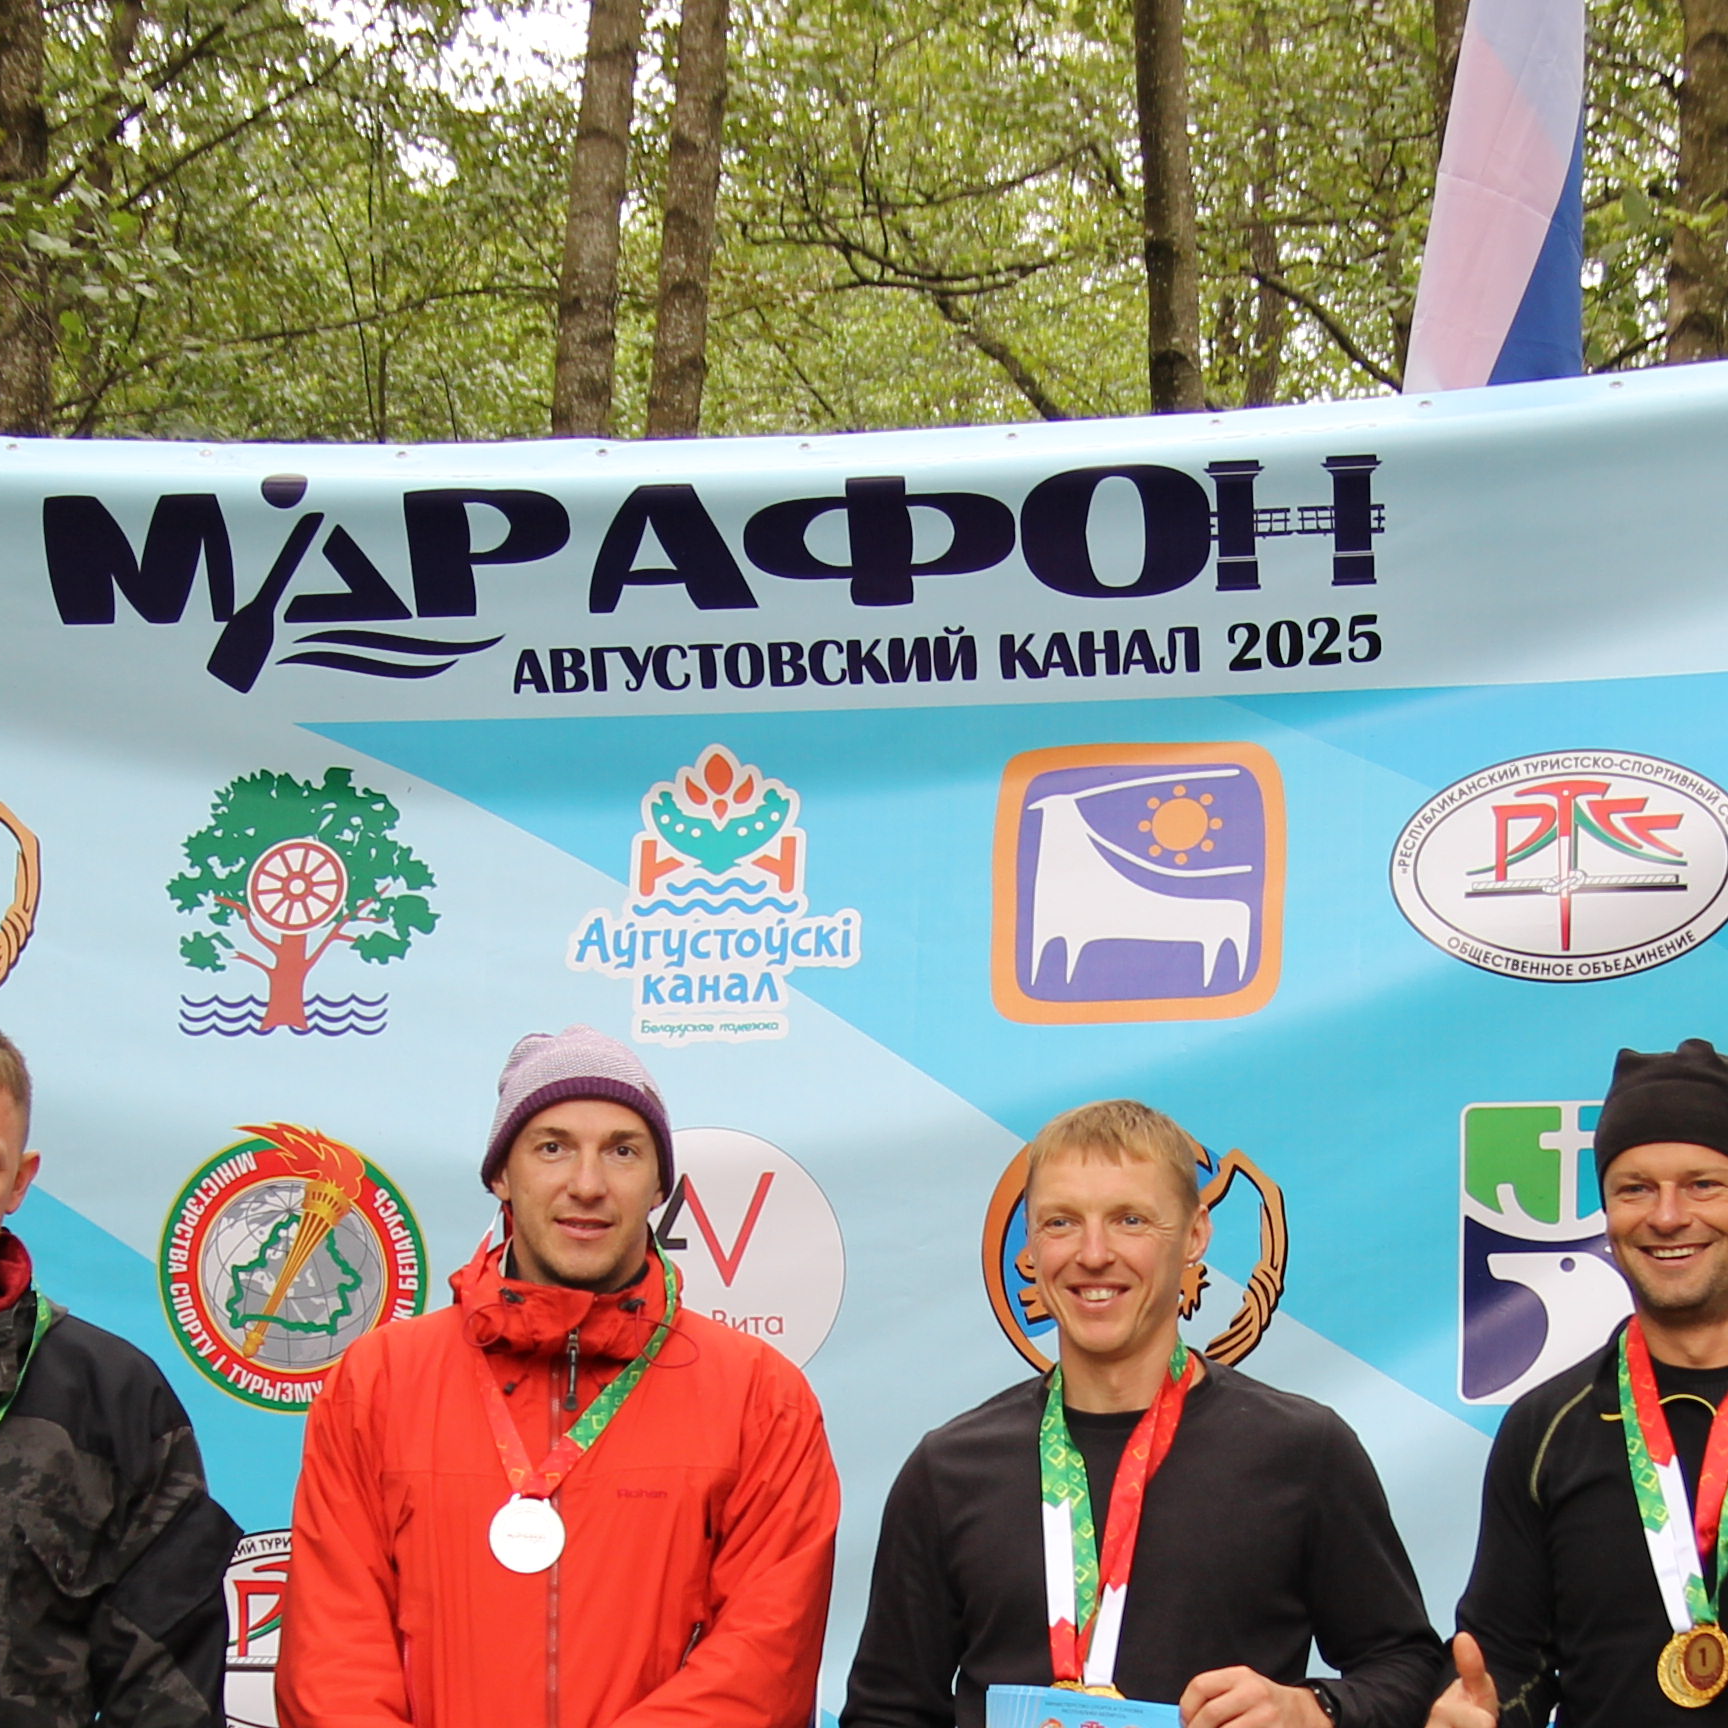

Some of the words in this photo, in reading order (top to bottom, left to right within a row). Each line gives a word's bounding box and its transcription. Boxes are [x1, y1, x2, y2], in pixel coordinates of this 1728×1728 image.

[43, 455, 1384, 693] МАРАФОН
[513, 625, 977, 694] АВГУСТОВСКИЙ
[999, 626, 1201, 681] КАНАЛ
[1227, 614, 1382, 671] 2025
[1525, 755, 1721, 808] ТУРИСТСКО-СПОРТИВНЫЙ
[1447, 935, 1574, 977] ОБЩЕСТВЕННОЕ
[1578, 929, 1697, 977] ОБЪЕДИНЕНИЕ
[641, 972, 779, 1005] канал
[641, 1020, 714, 1038] Беларускае
[168, 1151, 258, 1274] МІНІСТЭРСТВА
[372, 1187, 420, 1291] БЕЛАРУСЬ
[170, 1282, 218, 1358] СПОРТУ
[711, 1309, 784, 1334] Вита
[1698, 1647, 1708, 1668] 1
